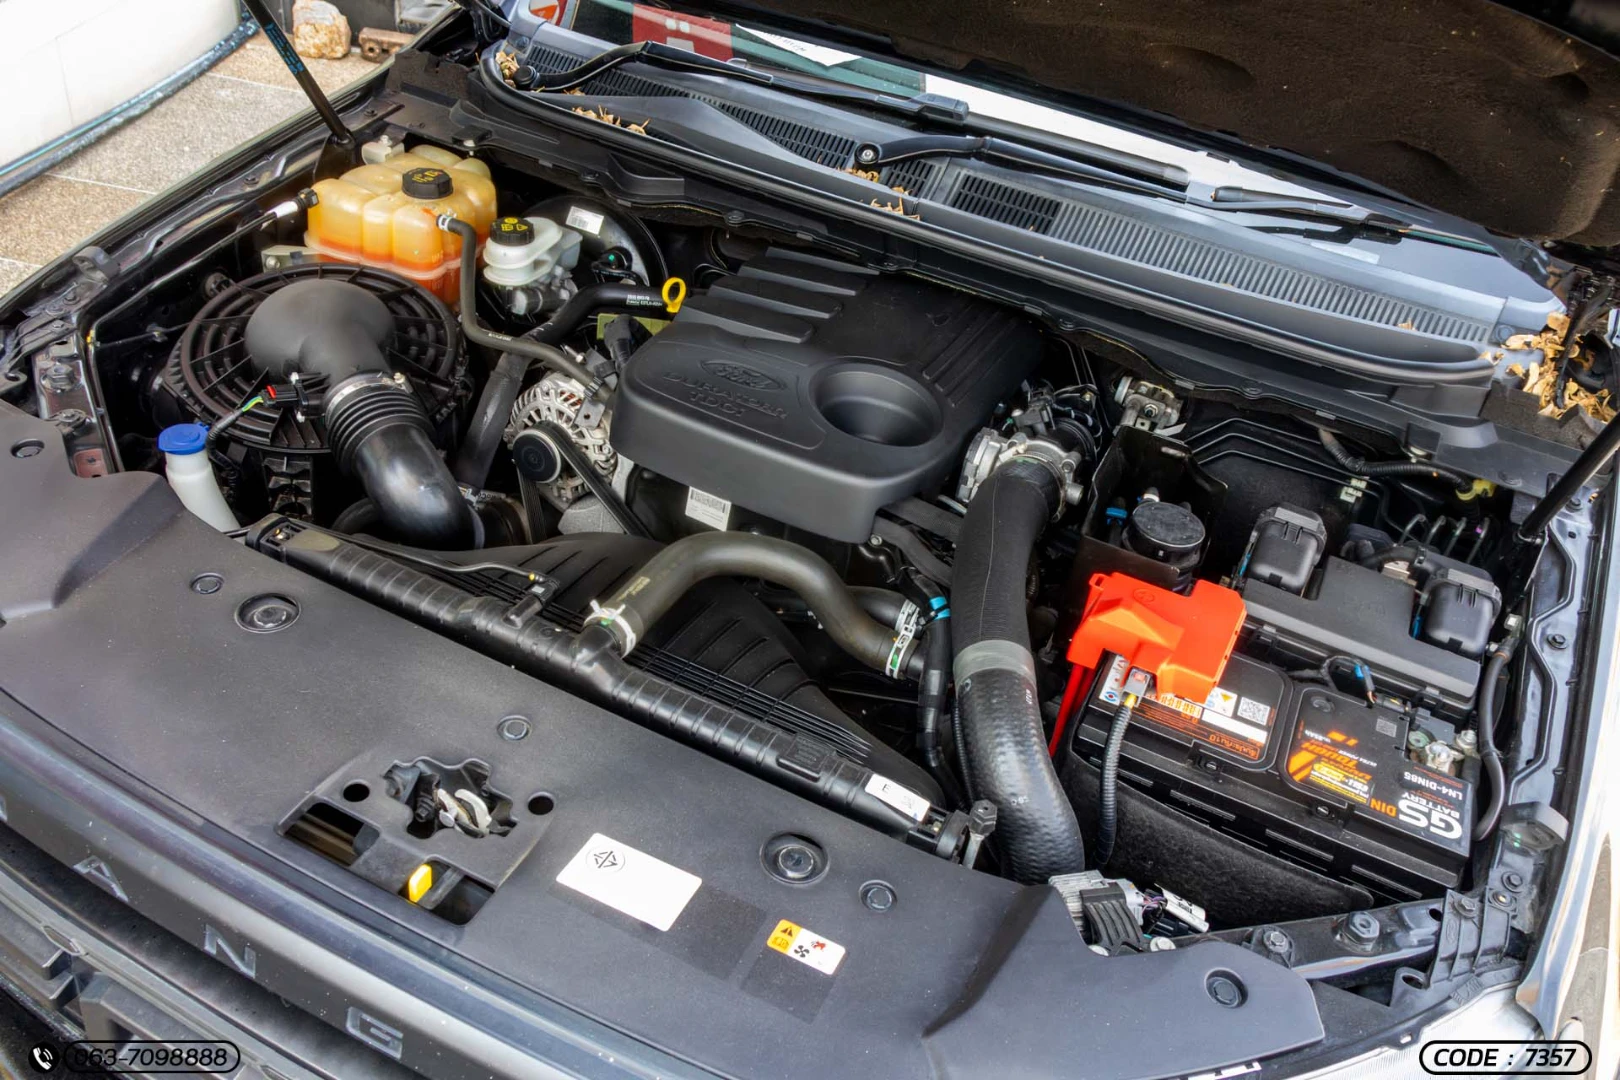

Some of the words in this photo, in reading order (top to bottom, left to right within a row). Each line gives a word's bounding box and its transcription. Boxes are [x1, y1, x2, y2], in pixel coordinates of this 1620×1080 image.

[1403, 771, 1463, 800] LN4-DIN85
[1370, 798, 1397, 818] DIN
[1398, 798, 1462, 839] GS
[1401, 791, 1460, 819] BATTERY
